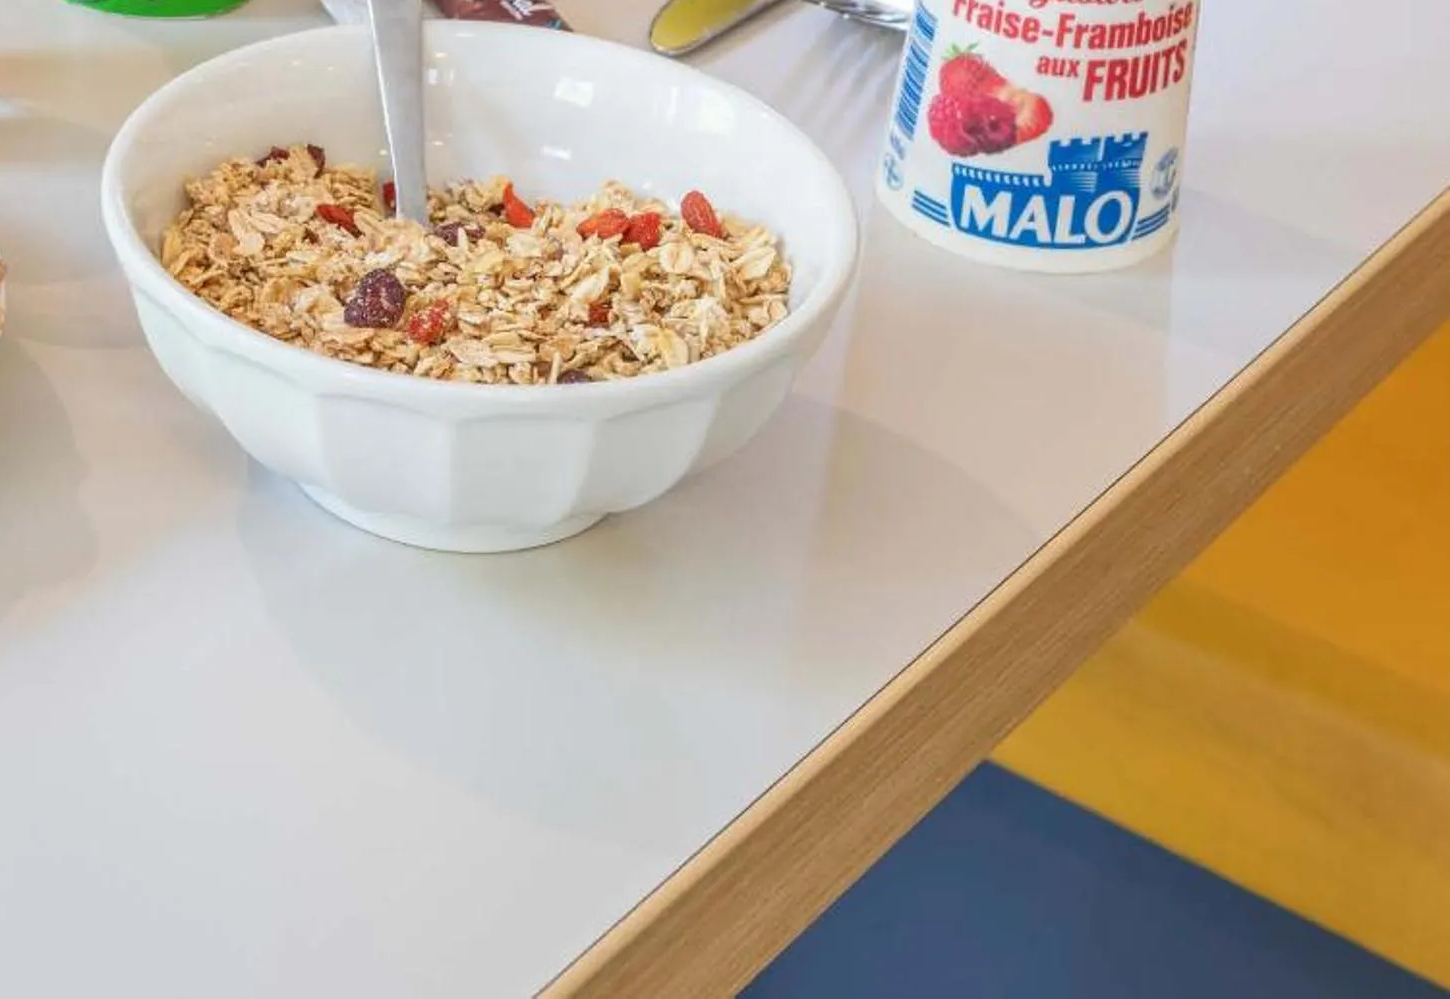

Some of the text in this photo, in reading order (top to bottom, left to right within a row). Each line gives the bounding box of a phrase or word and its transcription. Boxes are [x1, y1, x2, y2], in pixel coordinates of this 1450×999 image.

[1036, 39, 1189, 103] aux FRUITS
[960, 185, 1134, 245] MALO
